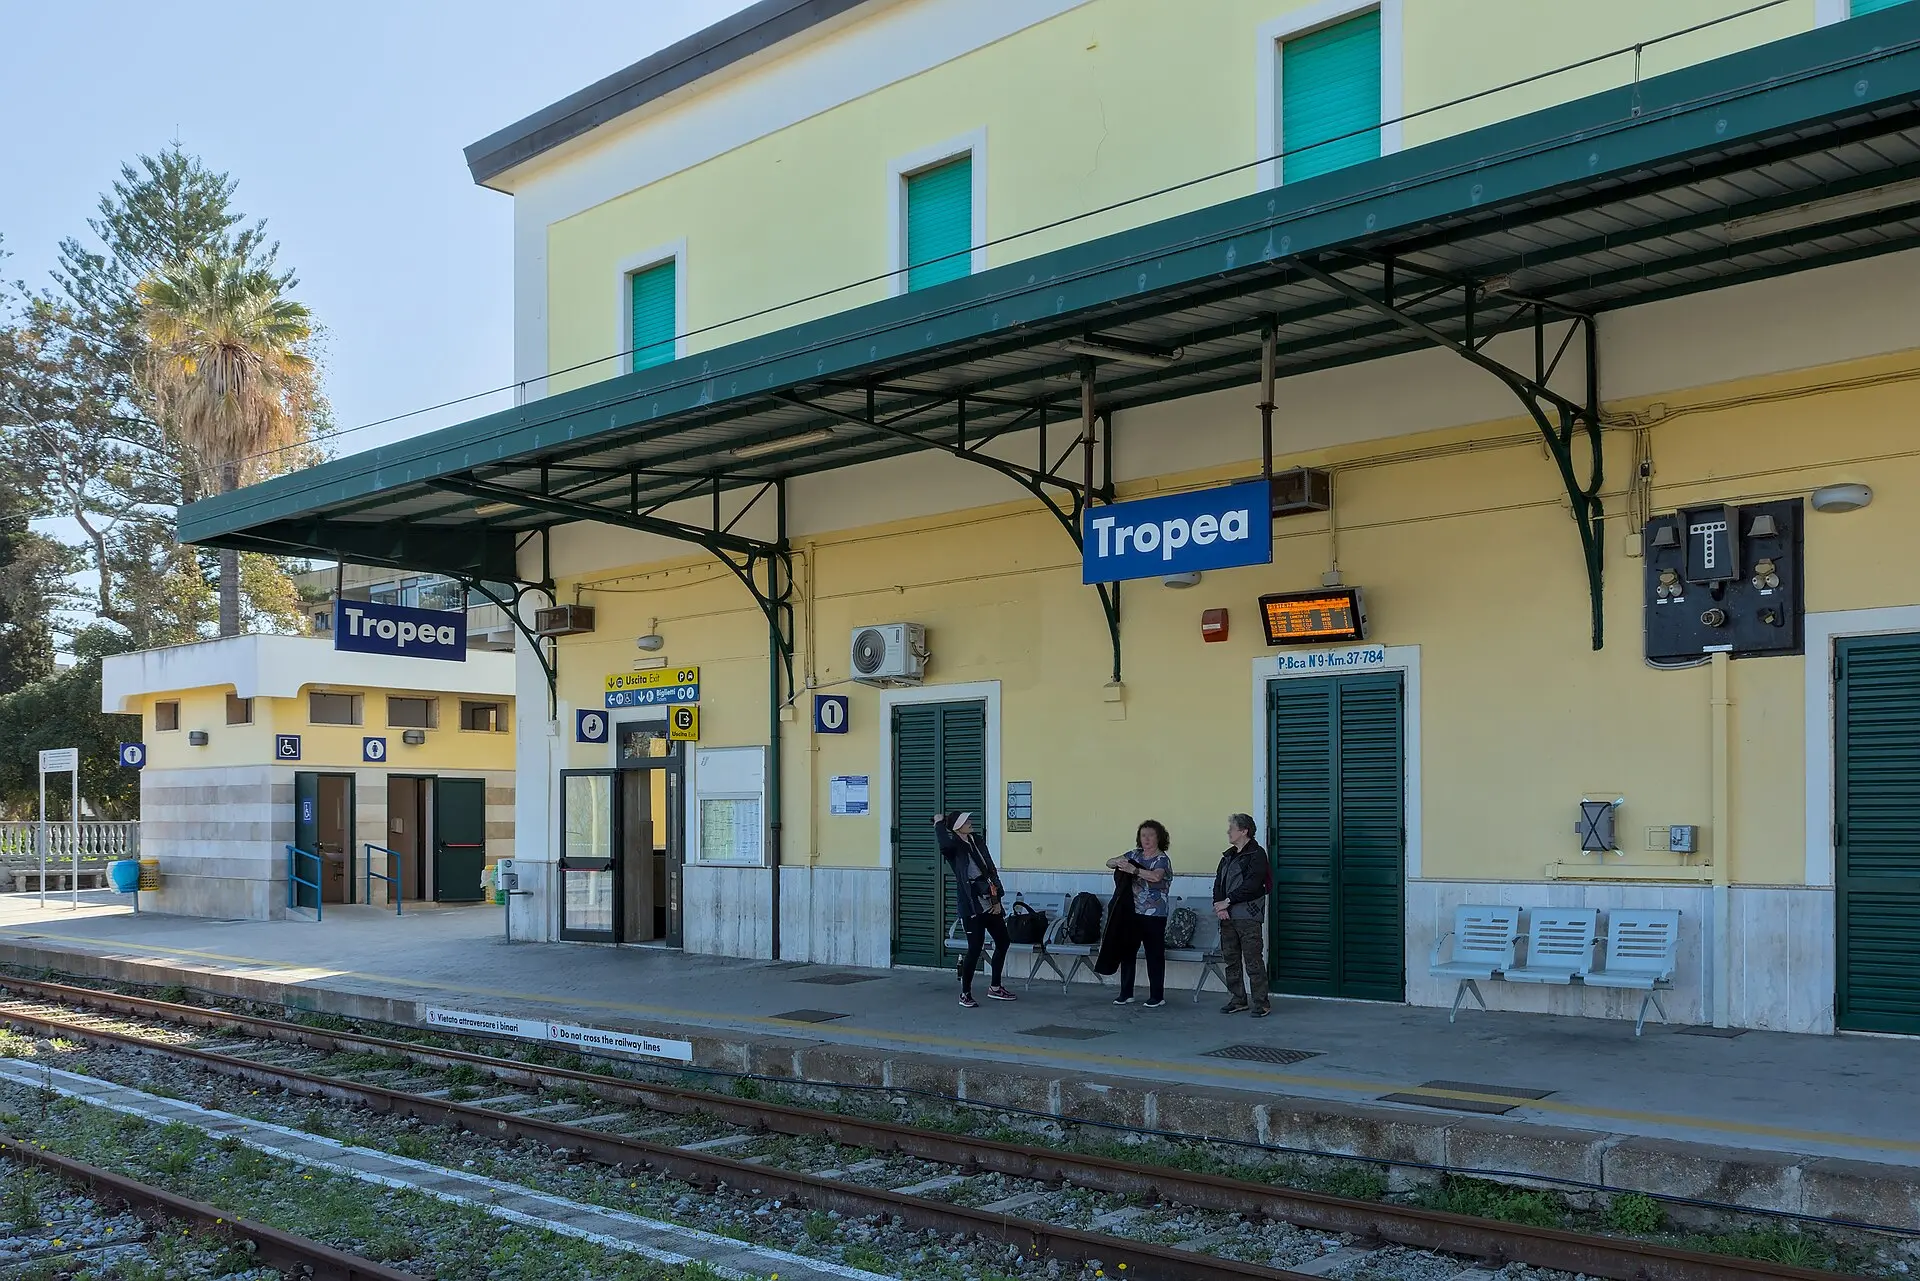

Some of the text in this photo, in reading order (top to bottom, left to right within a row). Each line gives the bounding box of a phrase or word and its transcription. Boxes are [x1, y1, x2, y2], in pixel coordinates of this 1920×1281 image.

[1092, 509, 1249, 561] Tropea
[1690, 521, 1727, 568] T
[345, 607, 455, 648] Tropea
[625, 673, 660, 685] Uscita Exit
[828, 705, 835, 723] 1
[437, 1013, 458, 1024] Vietato
[459, 1017, 496, 1029] attraversare
[500, 1021, 519, 1032] binari
[560, 1029, 661, 1052] Do not cross the railway lines
